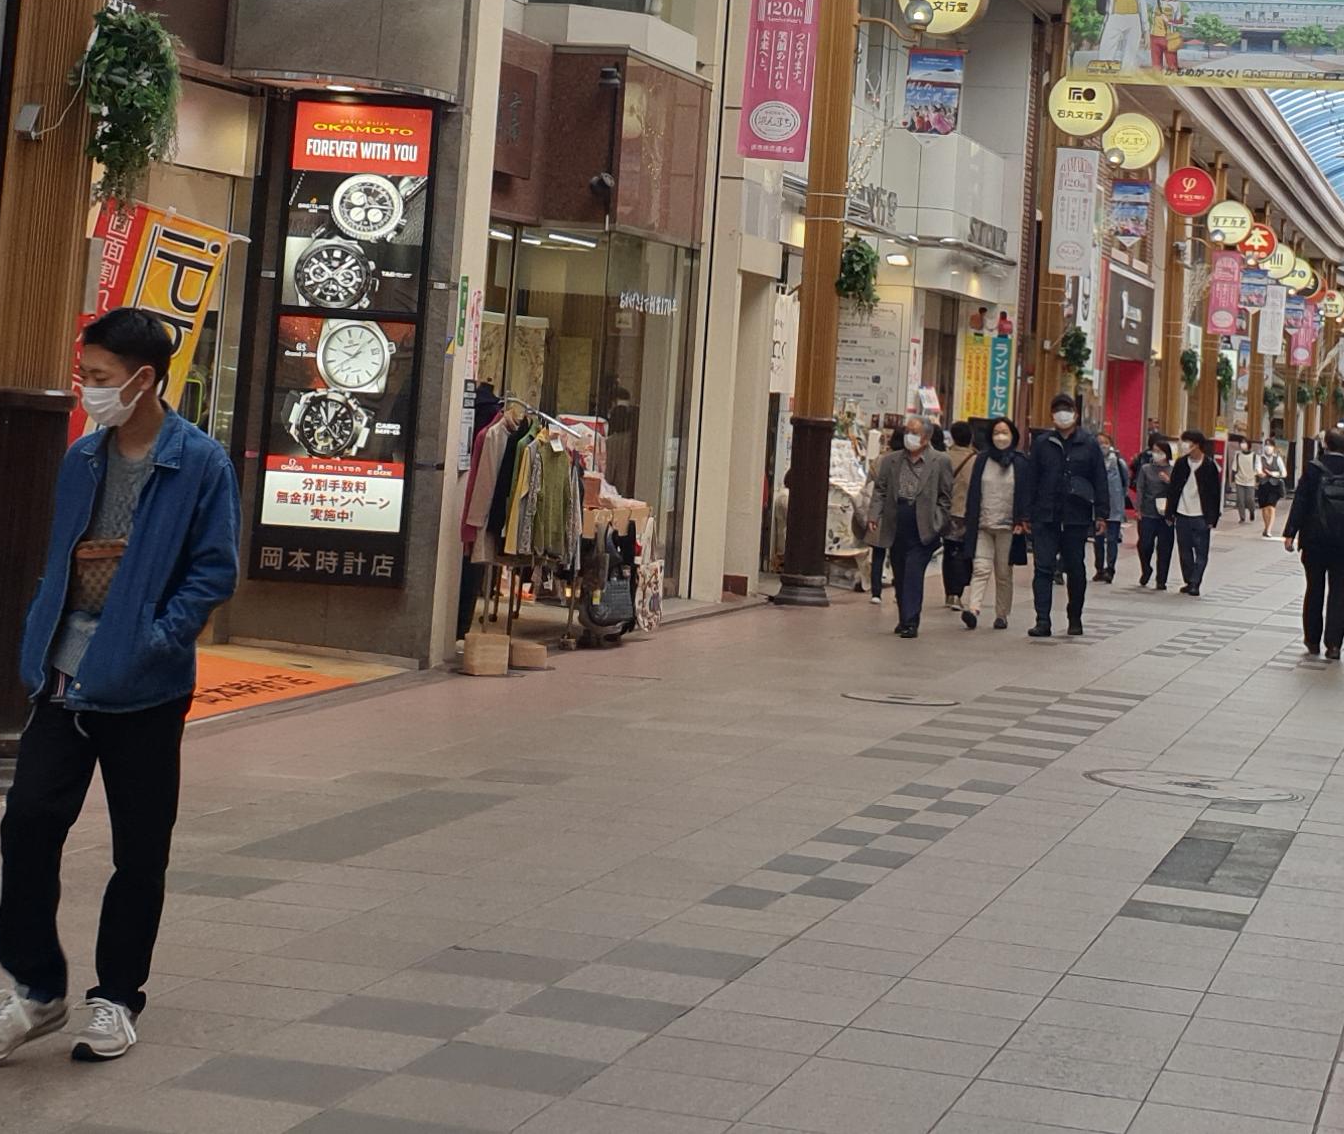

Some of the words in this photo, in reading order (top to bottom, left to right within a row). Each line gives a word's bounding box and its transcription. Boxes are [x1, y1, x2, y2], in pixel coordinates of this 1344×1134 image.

[766, 2, 803, 18] 120th
[1056, 109, 1104, 121] 石丸文行堂
[313, 123, 414, 136] OKAMOTO
[306, 138, 357, 158] FOREVER
[360, 143, 390, 161] WITH
[393, 144, 418, 162] YOU
[991, 342, 1008, 418] ランドセル
[302, 478, 368, 494] 分割手数料
[276, 491, 391, 510] 無金利キャンペーン
[259, 546, 395, 578] 岡本時計店
